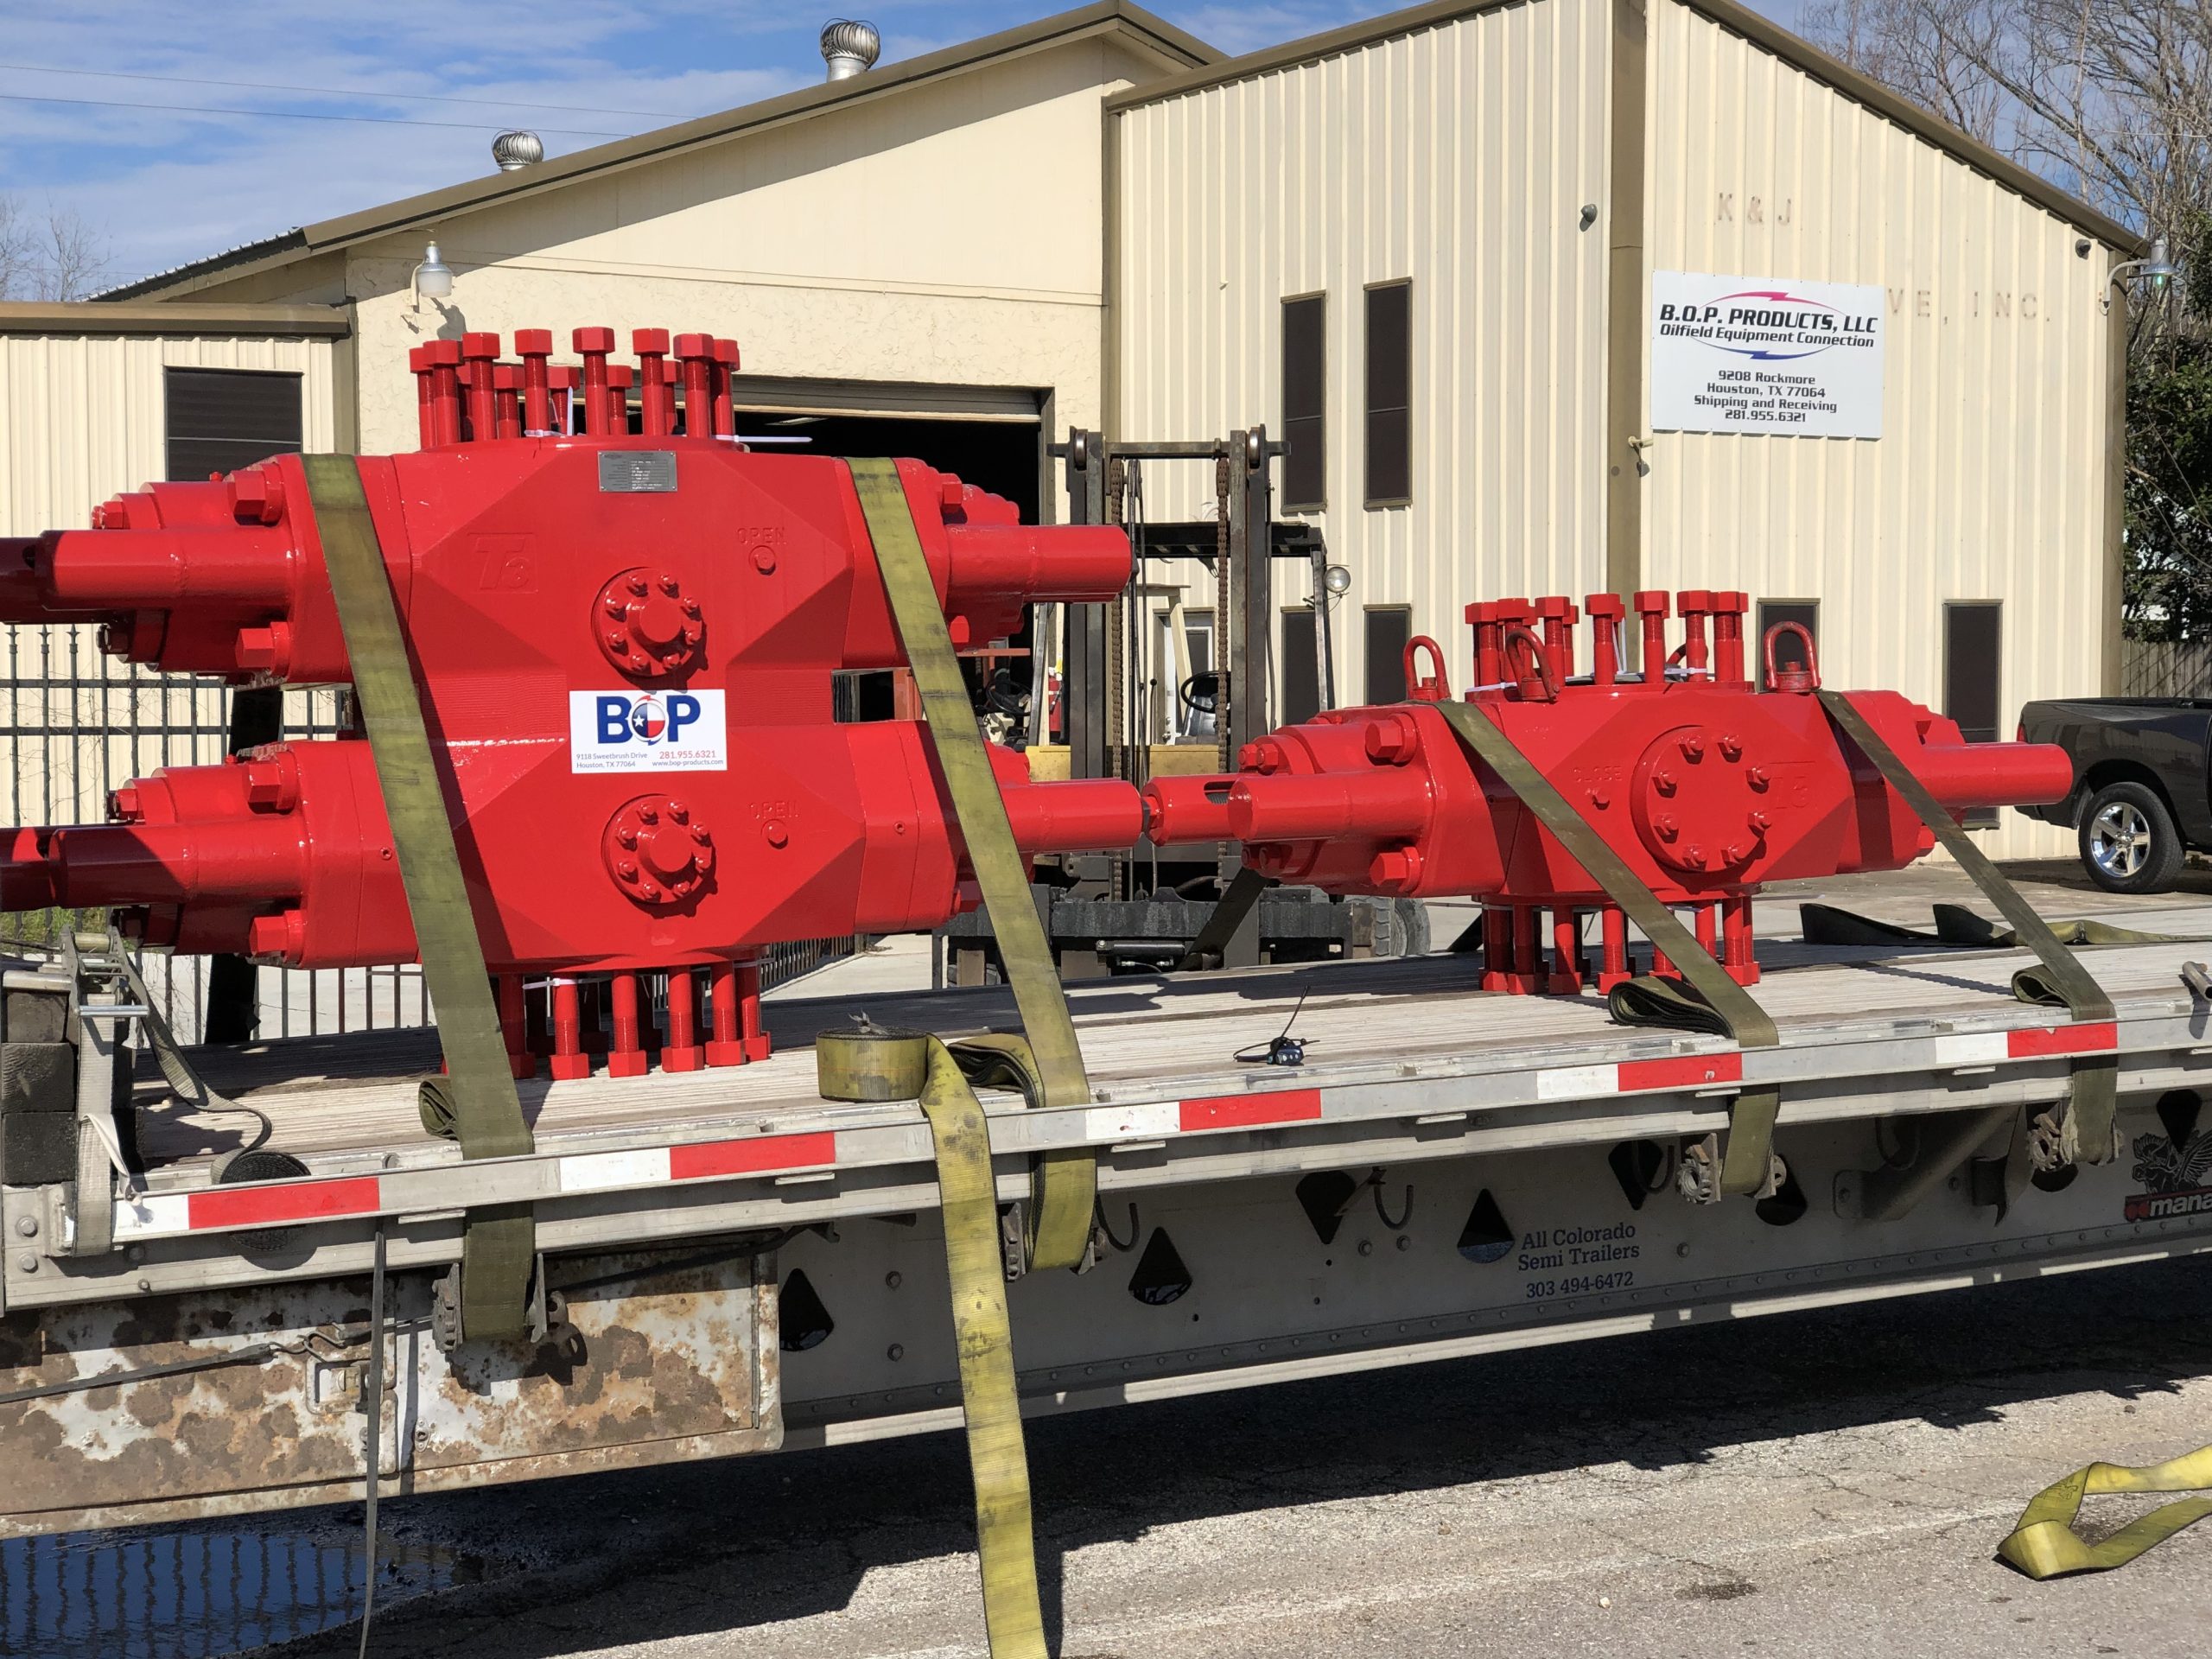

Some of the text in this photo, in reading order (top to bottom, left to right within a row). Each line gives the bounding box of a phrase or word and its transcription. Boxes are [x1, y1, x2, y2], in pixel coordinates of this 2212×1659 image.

[1718, 192, 1792, 225] K & J
[1660, 303, 1878, 334] B.O.P. PRODUCTS, LLC
[1660, 323, 1874, 347] Oilfield Equipment Connection
[1719, 370, 1816, 385] 9208 Rockmore
[1707, 382, 1827, 398] Houston, TX 77064
[1694, 395, 1838, 414] Shipping and Receiving
[1725, 410, 1807, 423] 281.955.6321
[596, 695, 701, 744] BOP
[652, 759, 724, 767] www.bop-products.com
[659, 750, 716, 760] 281.955.6321
[1521, 1222, 1637, 1250] All Colorado
[1518, 1244, 1640, 1271] Semi Trailers
[1526, 1271, 1634, 1299] 303 494-6472
